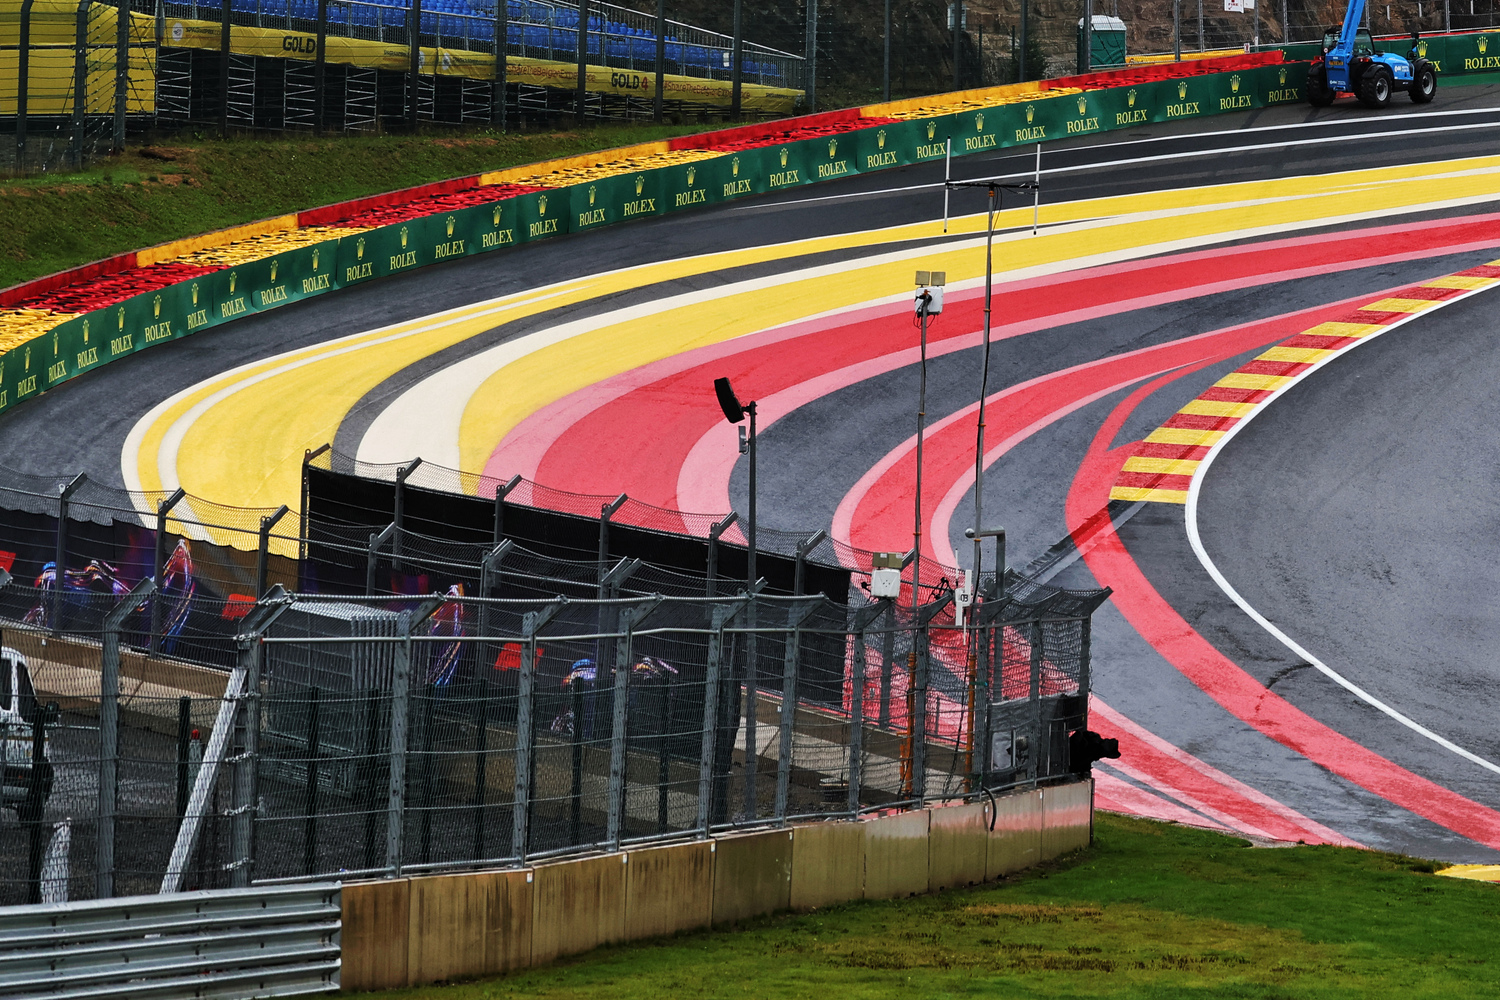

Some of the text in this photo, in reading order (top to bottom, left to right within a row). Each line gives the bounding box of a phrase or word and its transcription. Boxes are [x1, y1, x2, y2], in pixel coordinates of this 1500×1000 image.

[283, 35, 316, 54] GOLD
[1464, 56, 1500, 70] ROLEX
[611, 73, 648, 90] GOLD 4
[1220, 94, 1252, 110] ROLEX
[1268, 88, 1299, 103] ROLEX
[1116, 109, 1148, 125] ROLEX
[1166, 102, 1200, 117] ROLEX
[1015, 125, 1046, 142] ROLEX
[1066, 117, 1099, 134] ROLEX
[916, 142, 947, 159] ROLEX
[965, 134, 996, 150] ROLEX
[818, 160, 848, 178] ROLEX
[867, 151, 897, 168] ROLEX
[723, 179, 751, 197] ROLEX
[769, 170, 799, 187] ROLEX
[623, 198, 656, 217] ROLEX
[675, 189, 706, 207] ROLEX
[579, 208, 606, 227] ROLEX
[529, 218, 558, 237] ROLEX
[482, 229, 513, 248] ROLEX
[435, 239, 465, 259] ROLEX
[390, 250, 417, 270] ROLEX
[346, 262, 372, 282] ROLEX
[302, 274, 330, 293] ROLEX
[260, 285, 288, 306] ROLEX
[221, 297, 247, 318] ROLEX
[187, 309, 208, 329] ROLEX
[144, 321, 172, 342] ROLEX
[110, 334, 133, 355] ROLEX
[77, 347, 98, 369] ROLEX
[48, 360, 67, 383] ROLEX
[18, 375, 37, 398] ROLEX
